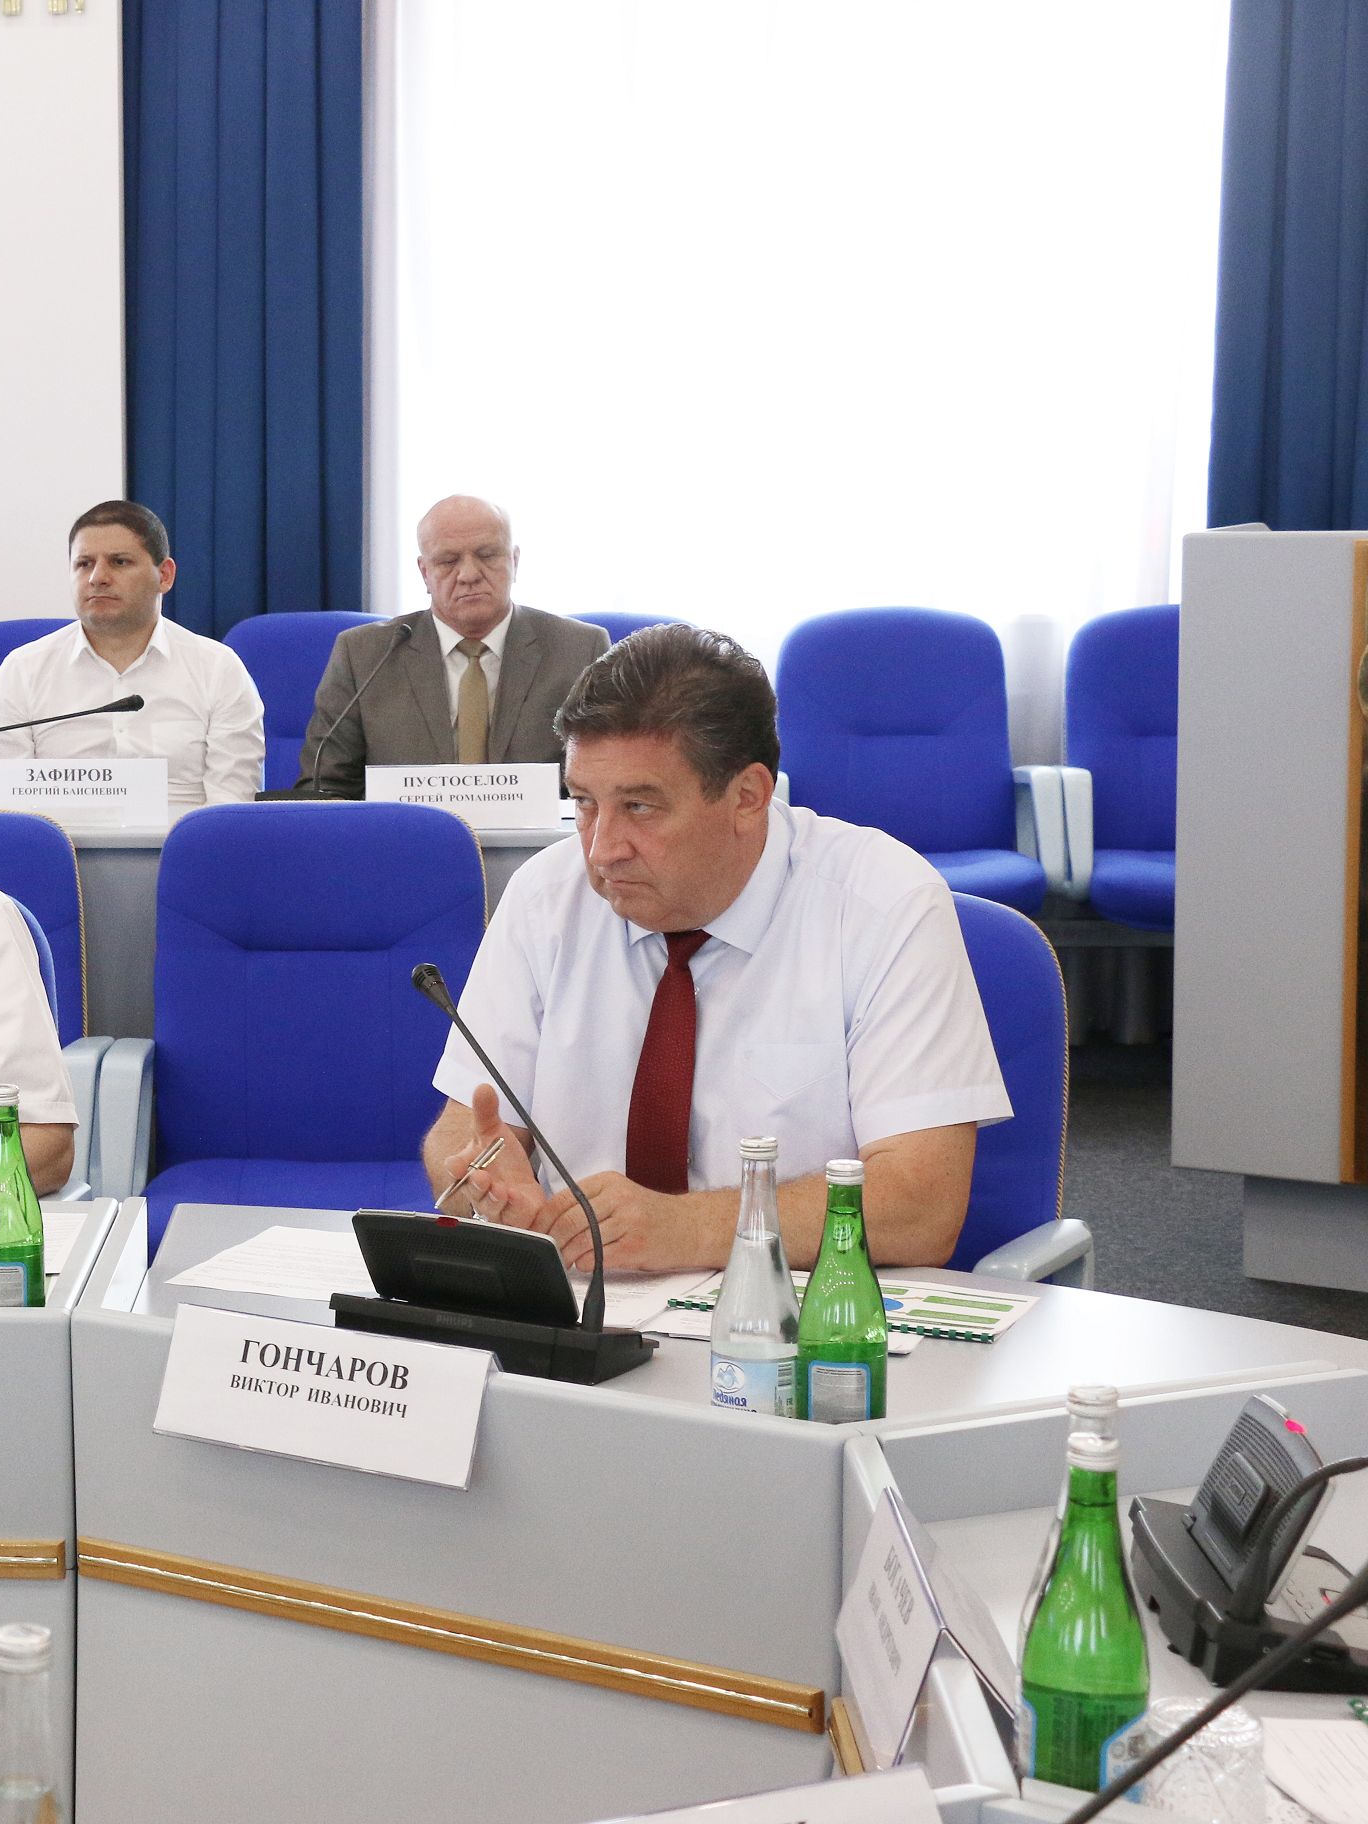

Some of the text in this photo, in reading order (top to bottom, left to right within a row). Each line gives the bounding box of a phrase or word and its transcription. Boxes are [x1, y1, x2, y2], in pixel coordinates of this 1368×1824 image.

[25, 768, 113, 782] ЗАФИРОВ
[403, 774, 519, 788] ПУСТОСЕЛОВ
[12, 786, 128, 796] ГЕОРГИЙ БАИСИЕВИЧ
[399, 792, 524, 804] СЕРГЕЙ РОМАНОВИЧ
[240, 1339, 409, 1390] ГОНЧАРОВ
[230, 1374, 408, 1418] ВИКТОР ИВАНОВИЧ
